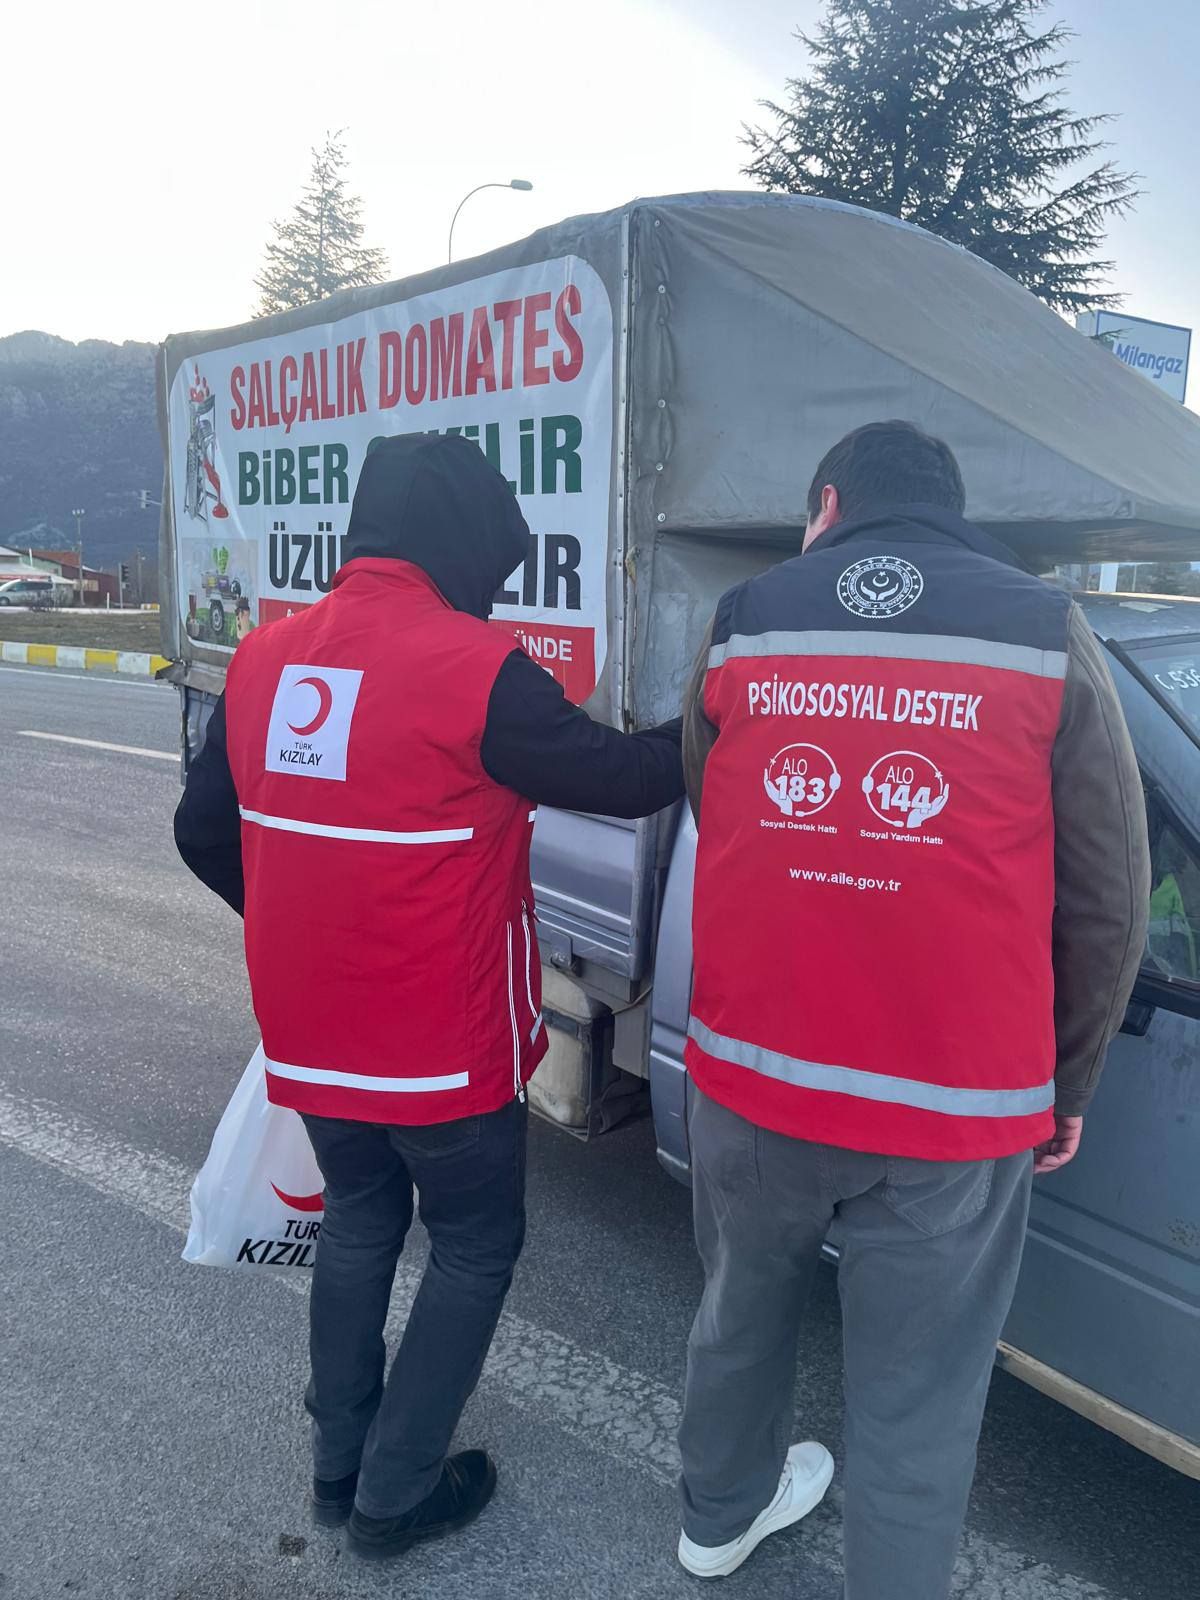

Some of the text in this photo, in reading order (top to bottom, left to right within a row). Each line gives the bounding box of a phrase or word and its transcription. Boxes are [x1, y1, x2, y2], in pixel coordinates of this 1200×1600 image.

[231, 284, 584, 433] SALÇALIK DOMATES
[1116, 344, 1184, 379] Milangaz
[748, 673, 983, 731] PSİKOSOSYAL DESTEK
[280, 749, 322, 766] KIZILAY
[295, 742, 313, 750] TÜRK
[781, 757, 807, 776] ALO
[884, 765, 914, 785] ALO
[774, 775, 826, 804] 183
[876, 782, 932, 814] 144
[760, 819, 838, 834] Sosyal Destek Hattı
[860, 829, 944, 845] Sosyal Yardım Hattı
[788, 863, 902, 892] www.aile.gov.tr
[284, 1220, 321, 1240] TÜR
[236, 1239, 315, 1267] KIZIL
